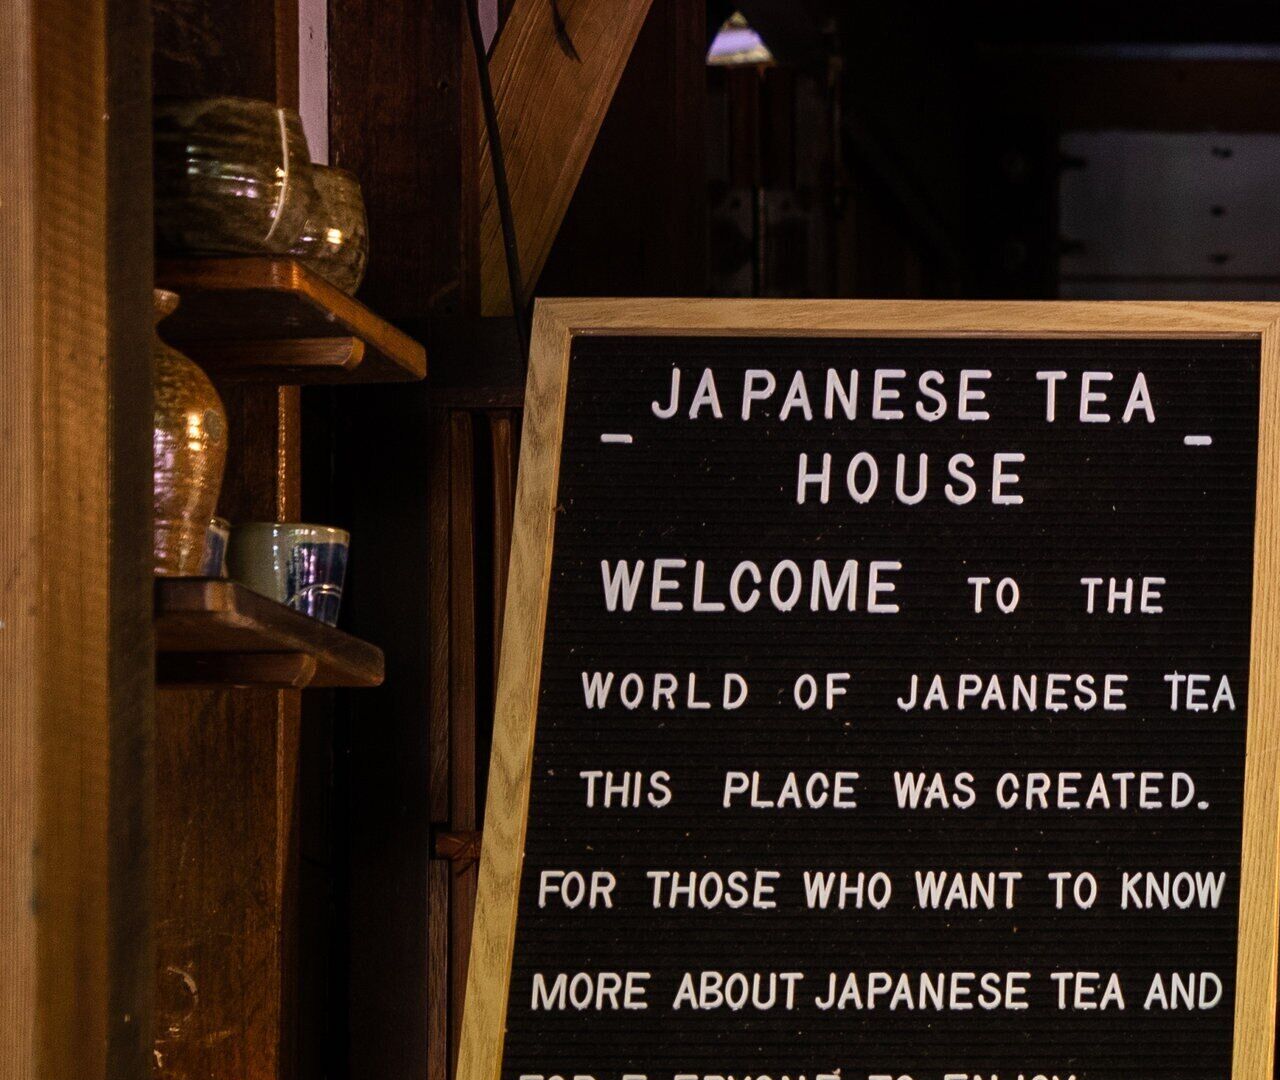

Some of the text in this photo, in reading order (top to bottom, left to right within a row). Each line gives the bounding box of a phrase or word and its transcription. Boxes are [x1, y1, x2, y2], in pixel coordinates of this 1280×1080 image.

[651, 366, 1156, 424] JAPANESE TEA
[796, 451, 1026, 507] HOUSE
[600, 557, 1166, 615] WELCOME TO THE
[581, 670, 1236, 714] WORLD OF JAPANESE TEA
[579, 770, 1209, 811] THIS PLACE WAS CREATED.
[538, 869, 1226, 911] FOR THOSE WHO WANT TO KNOW
[531, 970, 1223, 1012] MORE ABOUT JAPANESE TEA AND
